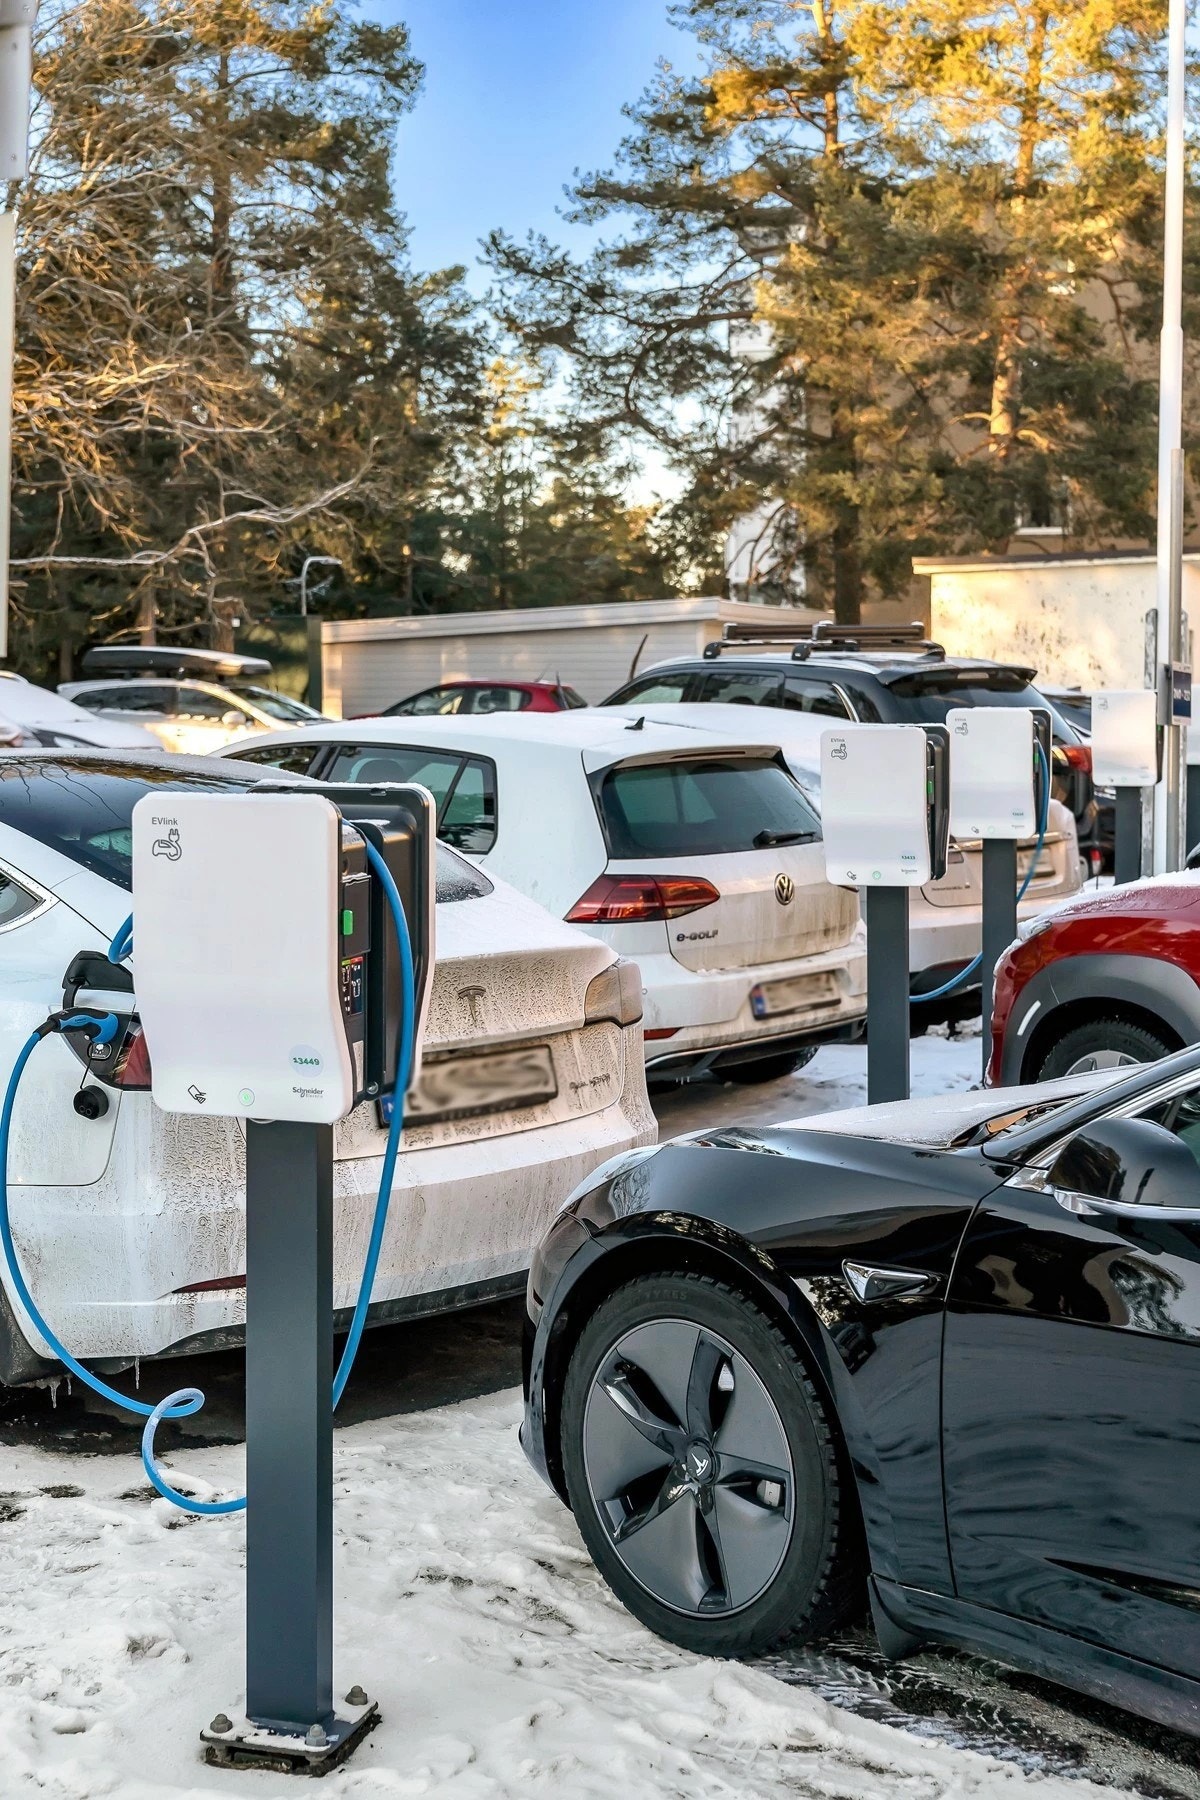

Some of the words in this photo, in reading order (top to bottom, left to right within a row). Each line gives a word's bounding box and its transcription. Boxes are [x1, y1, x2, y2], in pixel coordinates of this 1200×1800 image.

[151, 816, 179, 826] EVlink
[292, 1057, 320, 1066] 13449
[292, 1086, 324, 1098] Schneider
